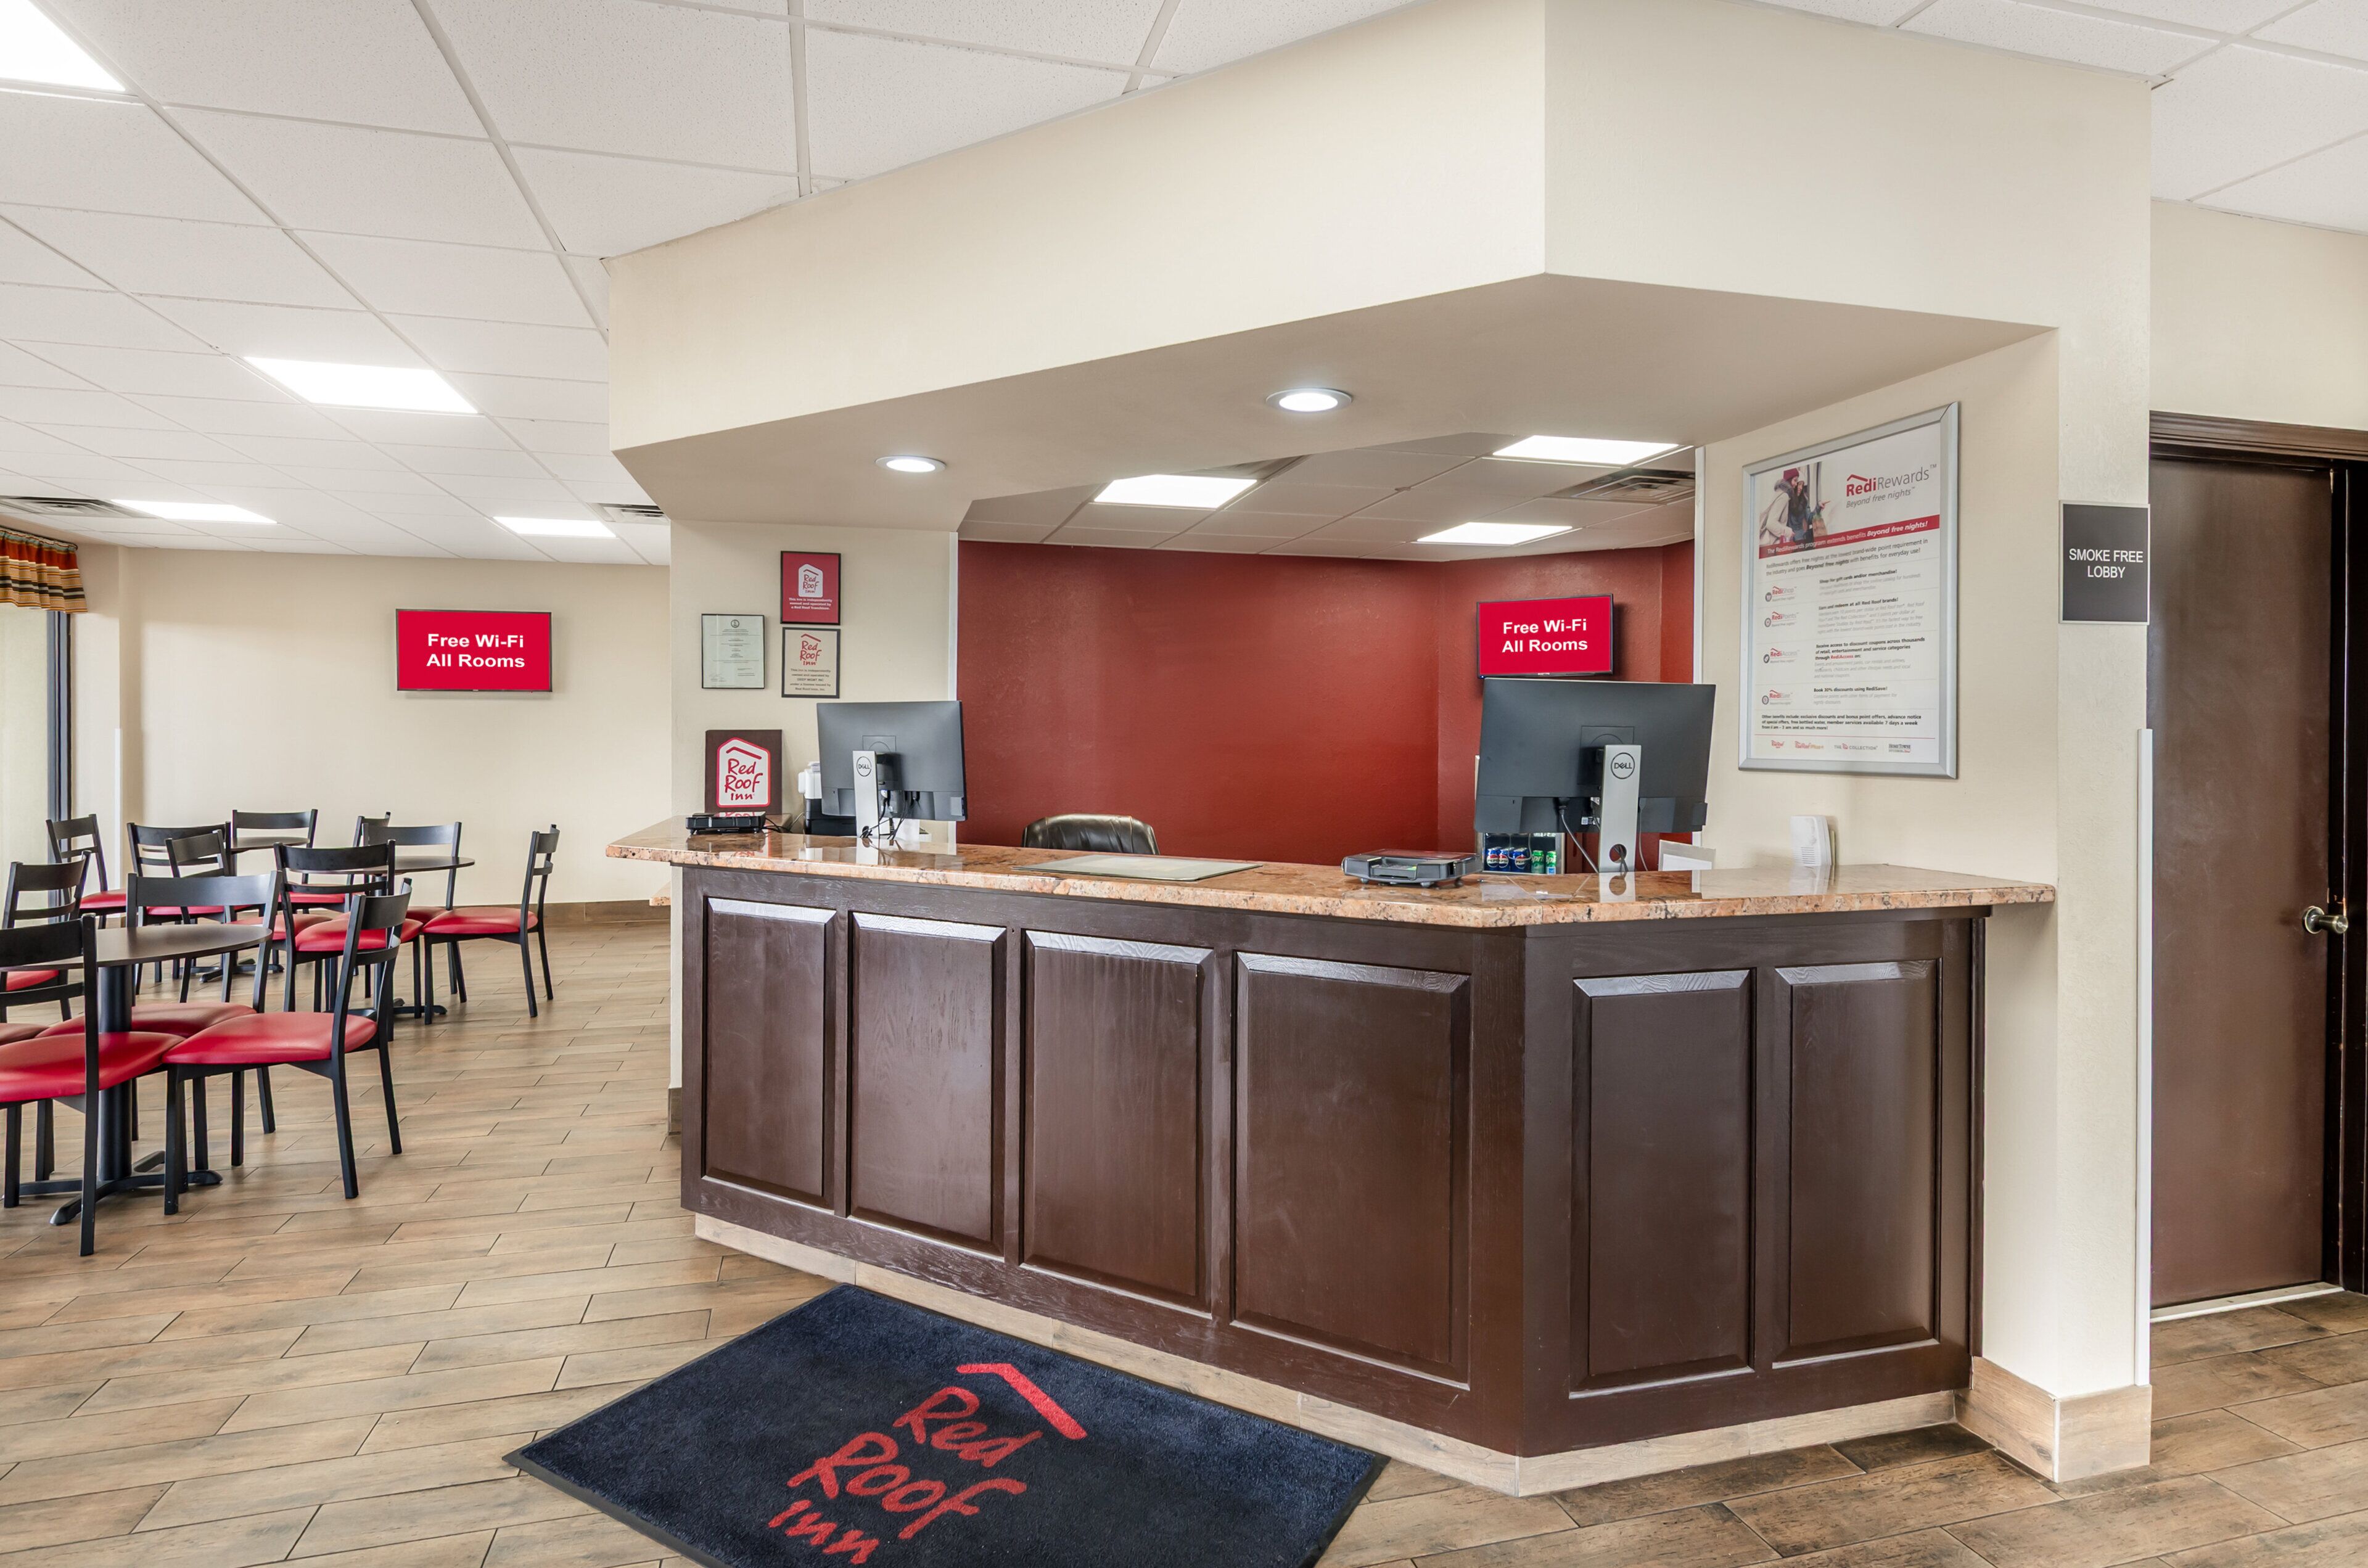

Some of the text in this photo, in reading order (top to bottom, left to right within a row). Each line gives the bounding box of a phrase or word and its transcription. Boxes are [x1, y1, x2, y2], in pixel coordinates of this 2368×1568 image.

[1846, 496, 1871, 509] Beyond
[1872, 495, 1885, 503] free
[1776, 543, 1804, 552] RediRewards
[1806, 540, 1825, 548] program
[1846, 532, 1866, 540] benefits
[1867, 527, 1889, 536] Beyond
[1905, 521, 1928, 530] nights!
[1892, 540, 1922, 549] requirement
[2069, 548, 2144, 563] SMOKE FREE
[1806, 562, 1824, 570] Beyond
[2087, 565, 2126, 578] LOBBY
[804, 574, 816, 582] Red
[803, 581, 820, 590] Roof
[1503, 618, 1587, 634] Free Wi-Fi
[428, 634, 524, 647] Free Wi-Fi
[802, 640, 818, 651] Red
[1502, 639, 1588, 653] All Rooms
[426, 654, 525, 668] All Rooms
[800, 649, 822, 662] Roof
[728, 758, 757, 775] Red
[725, 773, 763, 793] Roof
[893, 1386, 1043, 1467] Red
[787, 1431, 1027, 1540] Roof
